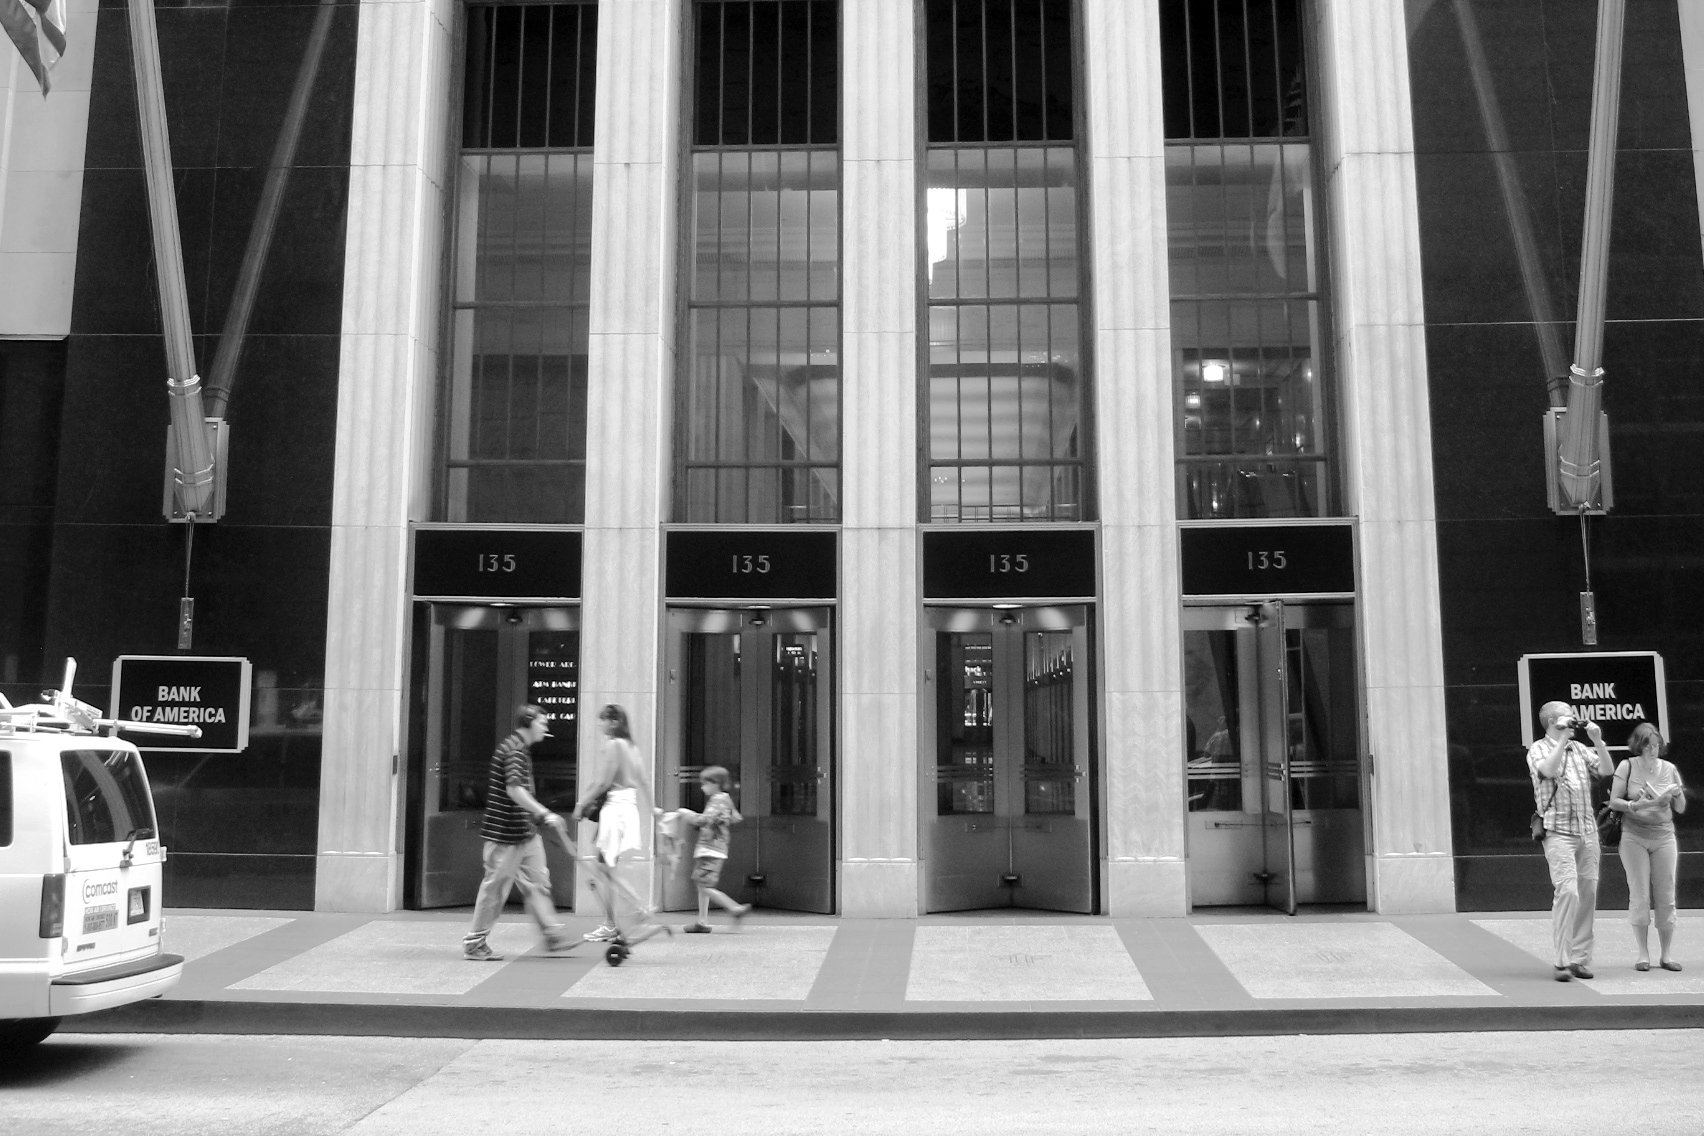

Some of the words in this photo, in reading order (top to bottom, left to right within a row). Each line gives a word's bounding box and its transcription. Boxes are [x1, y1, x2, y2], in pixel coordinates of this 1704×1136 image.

[478, 553, 517, 573] 135
[732, 554, 772, 574] 135
[990, 553, 1030, 573] 135
[1247, 550, 1288, 570] 135
[158, 685, 202, 702] BANK
[1570, 682, 1617, 700] BANK
[131, 705, 153, 722] OF
[153, 706, 226, 723] AMERICA
[1571, 703, 1646, 722] AMERICA
